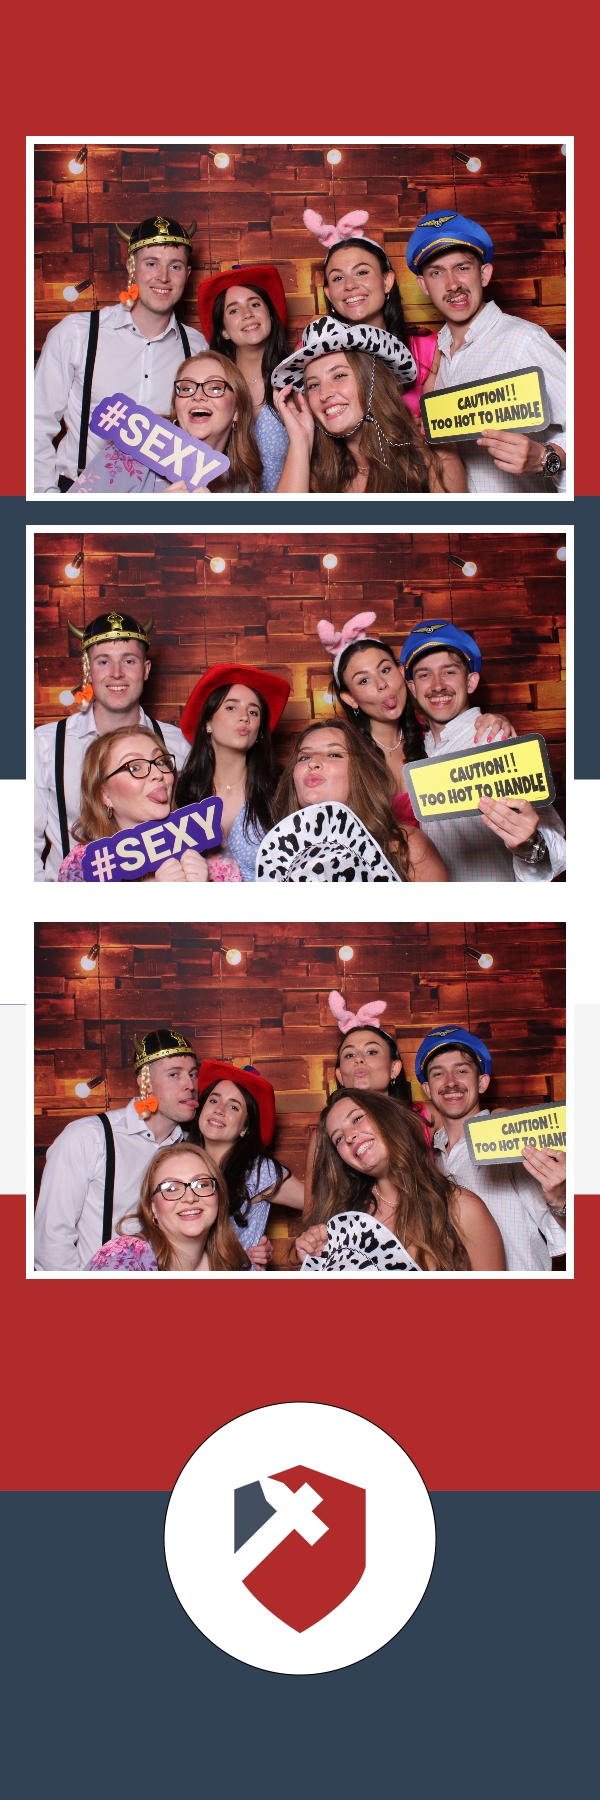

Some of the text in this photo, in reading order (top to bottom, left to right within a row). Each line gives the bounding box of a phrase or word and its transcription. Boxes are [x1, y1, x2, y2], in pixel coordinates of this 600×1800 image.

[457, 383, 517, 410] CAUTION!!
[431, 401, 541, 430] TOO HOT TO HANDLE
[98, 401, 222, 486] #SEXY
[450, 752, 518, 783] CAUTION!!
[419, 773, 546, 807] TOO HOT TO HANDLE
[91, 804, 216, 882] #SEXY
[501, 1113, 559, 1135] CAUTION!!
[475, 1141, 497, 1153] TOO
[498, 1138, 520, 1151] HOT
[521, 1137, 537, 1148] TO
